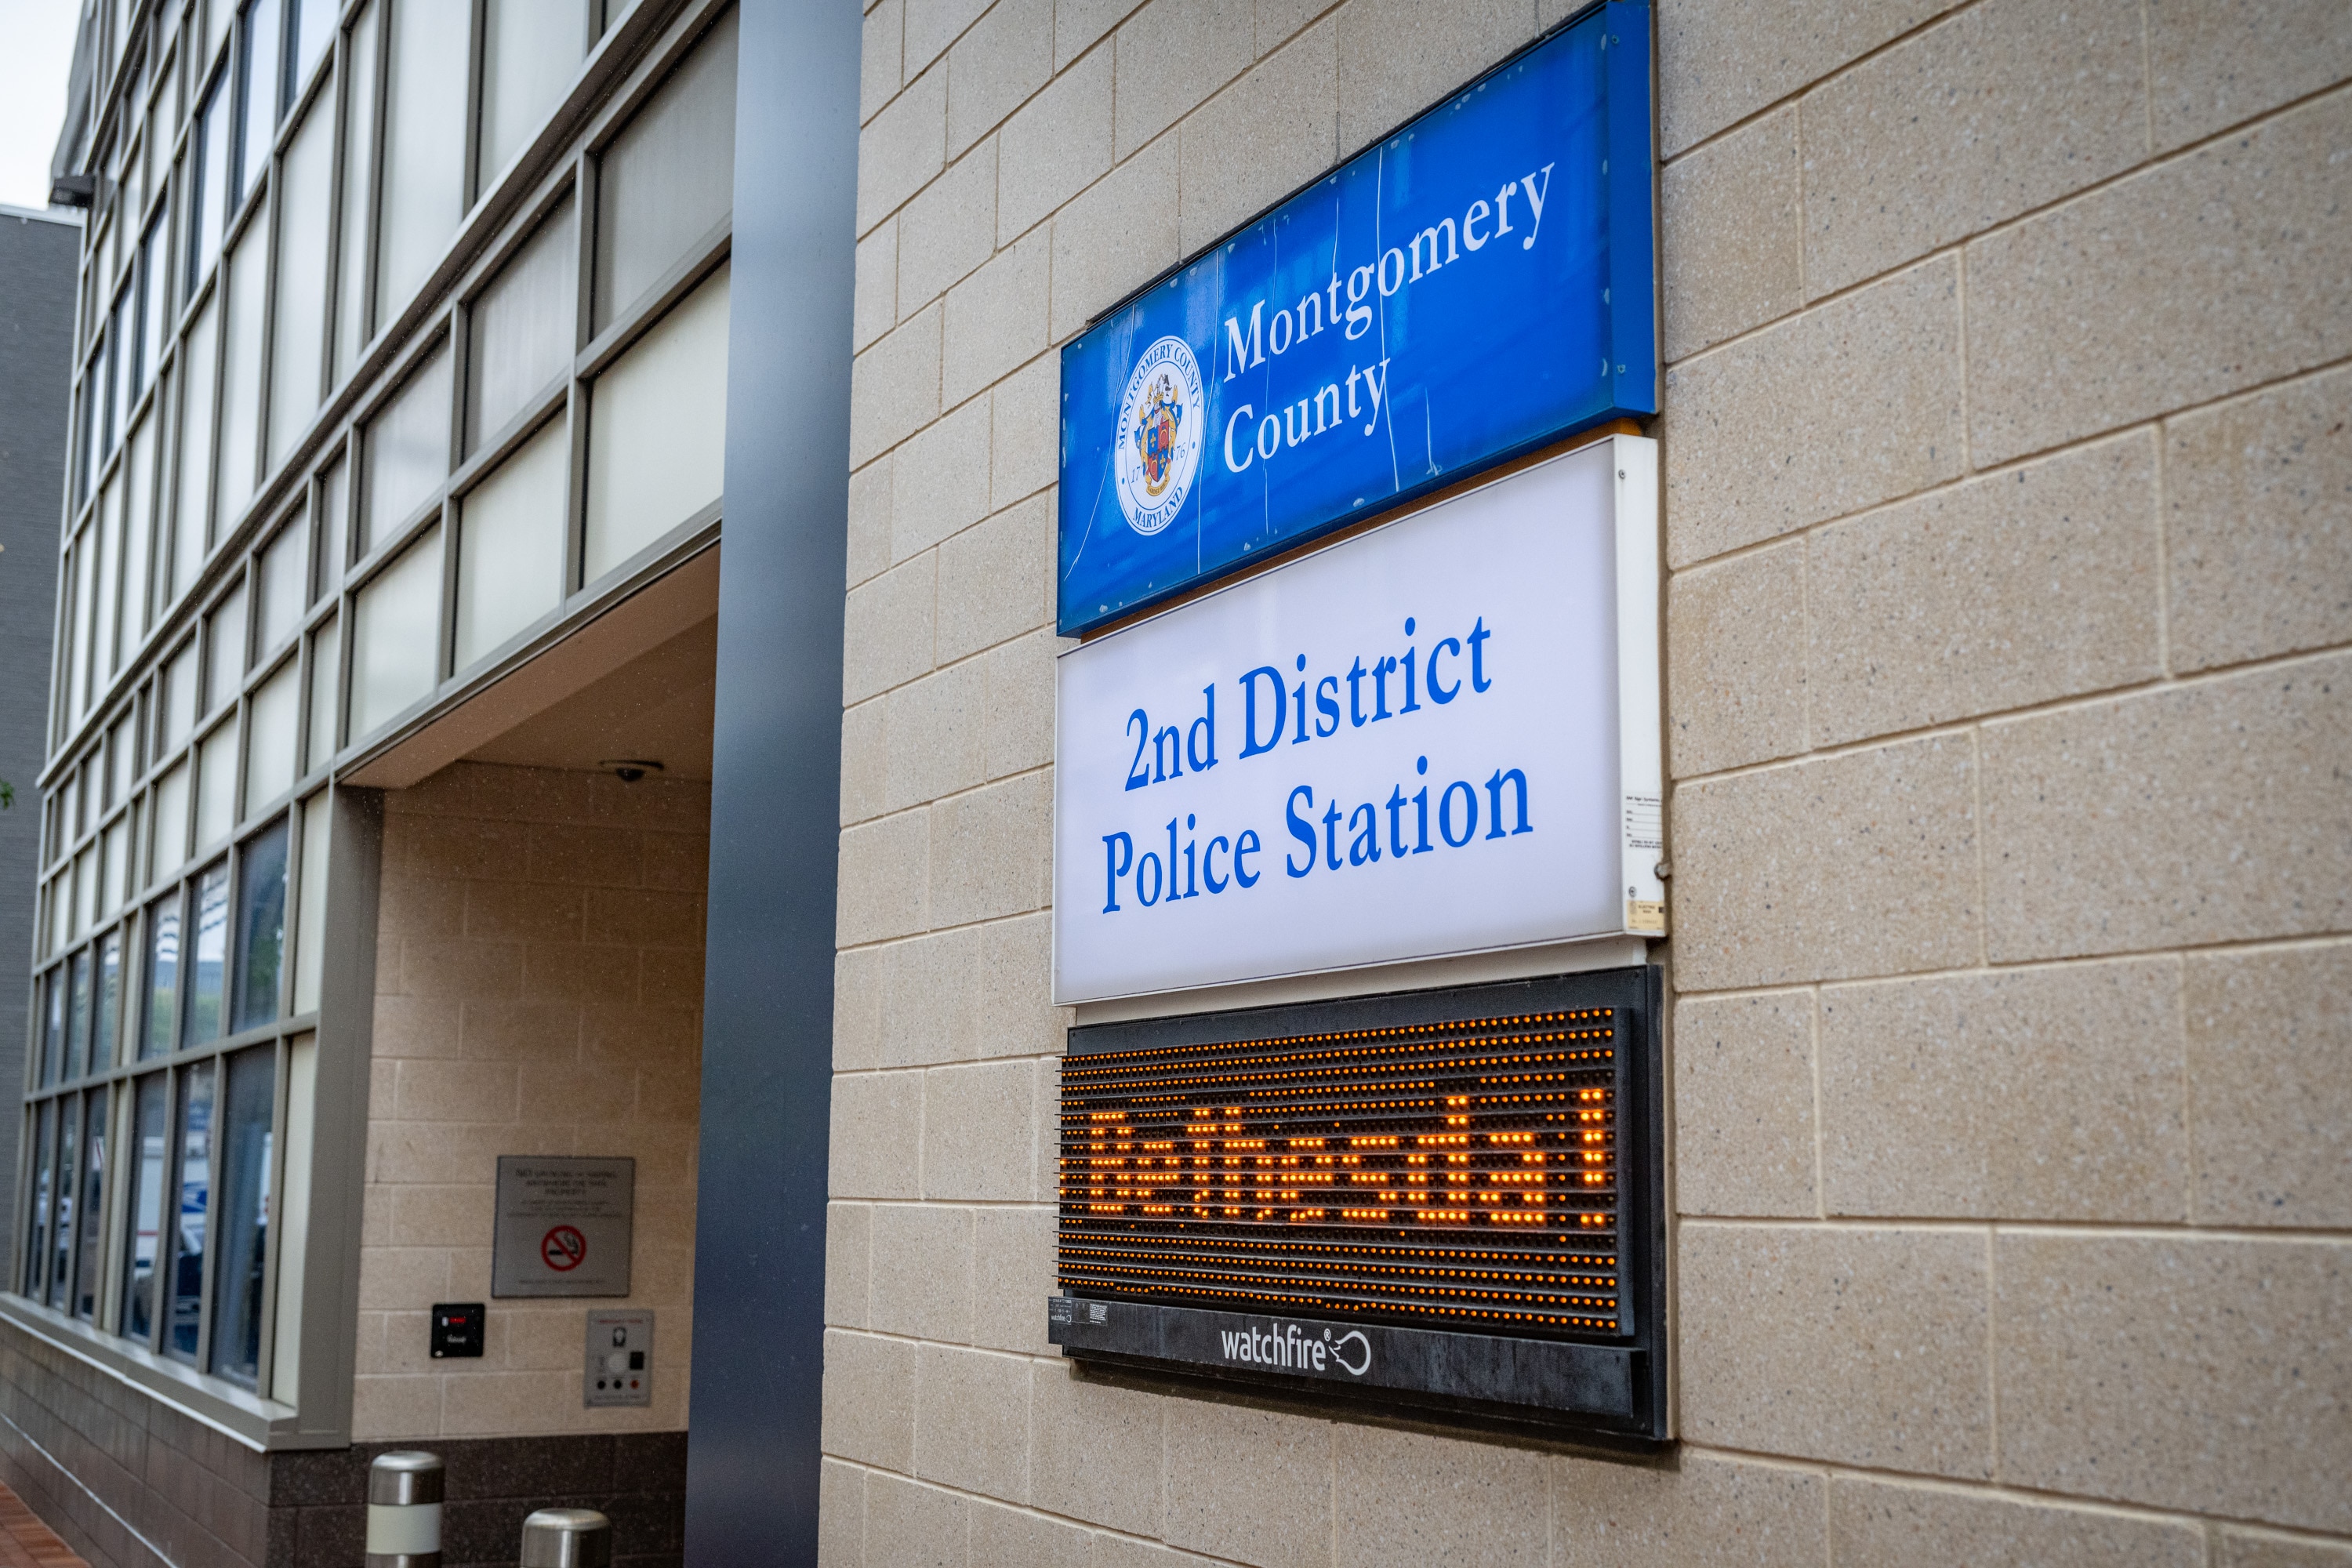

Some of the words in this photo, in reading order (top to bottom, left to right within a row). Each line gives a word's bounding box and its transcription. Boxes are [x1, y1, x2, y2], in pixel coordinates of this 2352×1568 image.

[1223, 162, 1555, 383] Montgomery
[1118, 343, 1174, 451] MONTGOMERY
[1174, 347, 1200, 409] COUNTY
[1175, 442, 1185, 461] 76
[1223, 358, 1391, 473] County
[1133, 486, 1184, 528] MARYLAND
[1124, 682, 1218, 792] 2nd
[1239, 615, 1493, 760] District
[1102, 812, 1261, 914] Police
[1286, 755, 1534, 879] Station
[1090, 1089, 1605, 1225] Bethesda!
